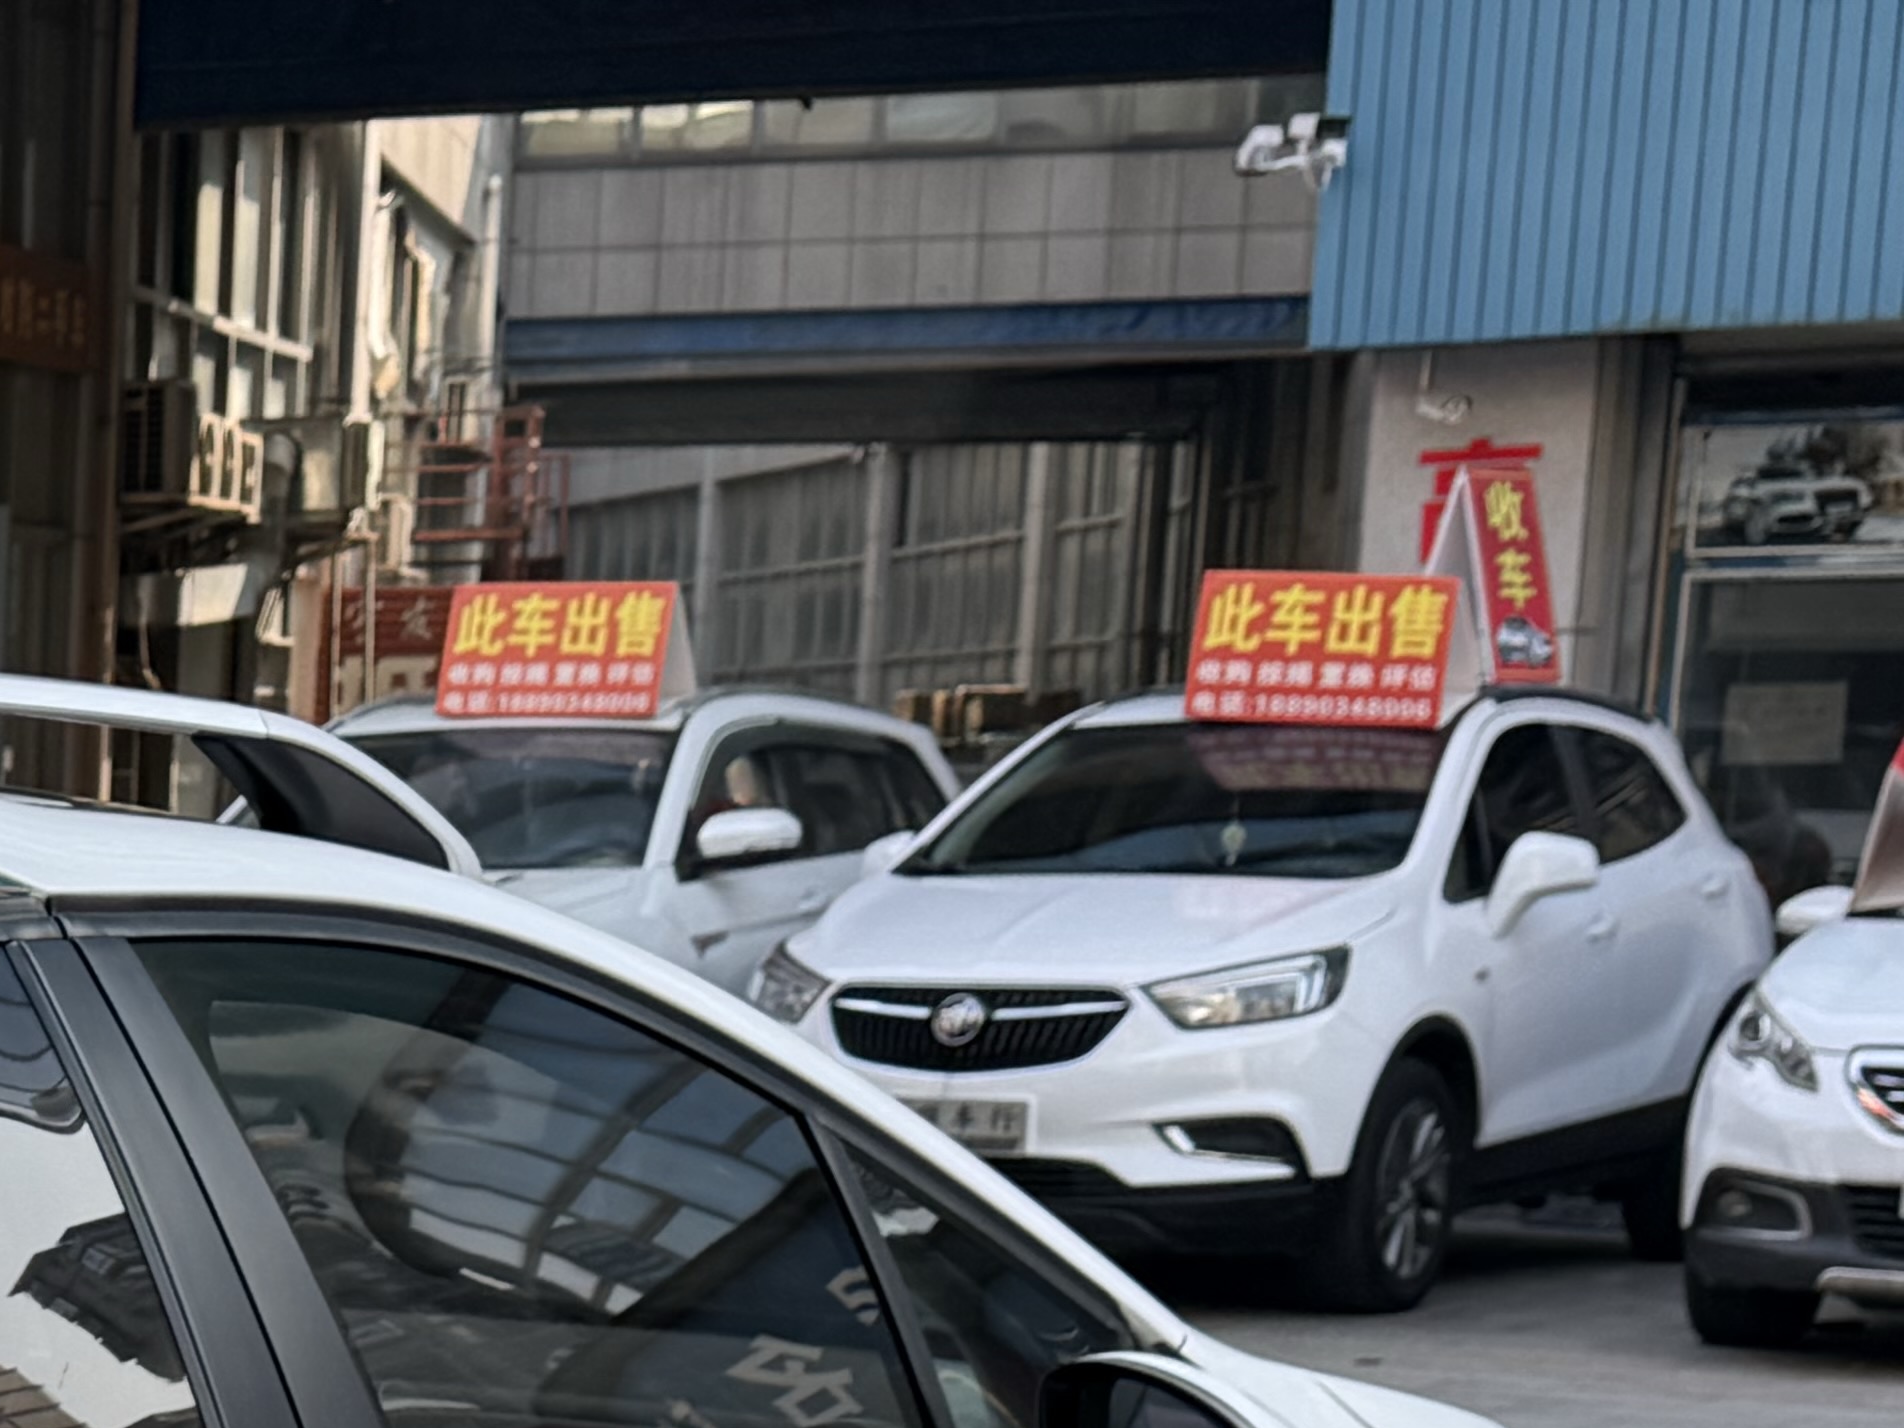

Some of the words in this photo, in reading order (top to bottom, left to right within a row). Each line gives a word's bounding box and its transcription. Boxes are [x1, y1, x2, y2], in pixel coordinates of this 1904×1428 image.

[453, 591, 667, 658] 此车出售
[1203, 582, 1449, 660] 此车出售
